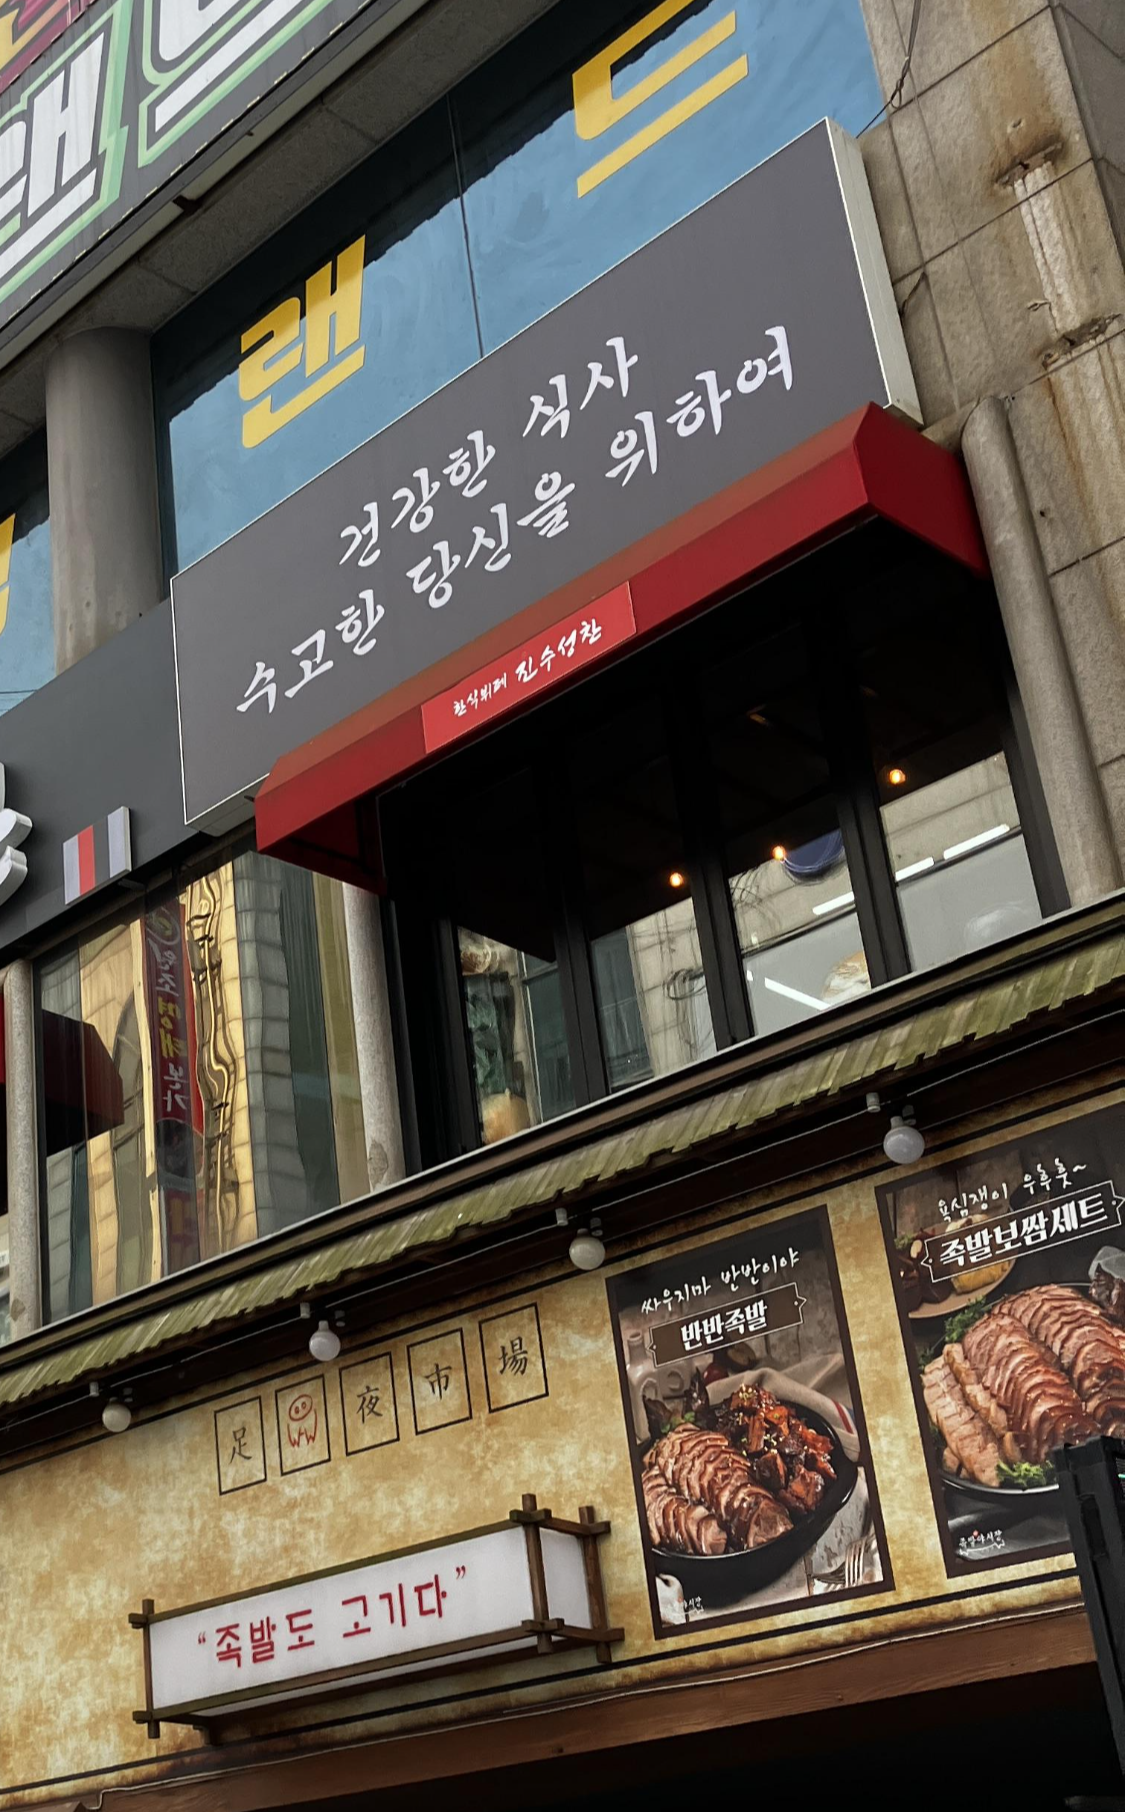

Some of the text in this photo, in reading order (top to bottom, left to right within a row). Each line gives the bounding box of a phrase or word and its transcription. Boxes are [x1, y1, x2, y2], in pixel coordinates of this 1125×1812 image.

[340, 336, 638, 567] 건강한 식사
[236, 325, 793, 713] 수고한 당신을 위하여
[453, 617, 602, 717] 한식뷔페 진수성찬
[938, 1182, 1008, 1222] 욕심쟁이
[940, 1193, 1108, 1267] 족발보쌈세트
[641, 1247, 799, 1315] 싸우지마 반반이야
[680, 1299, 768, 1351] 반반족발
